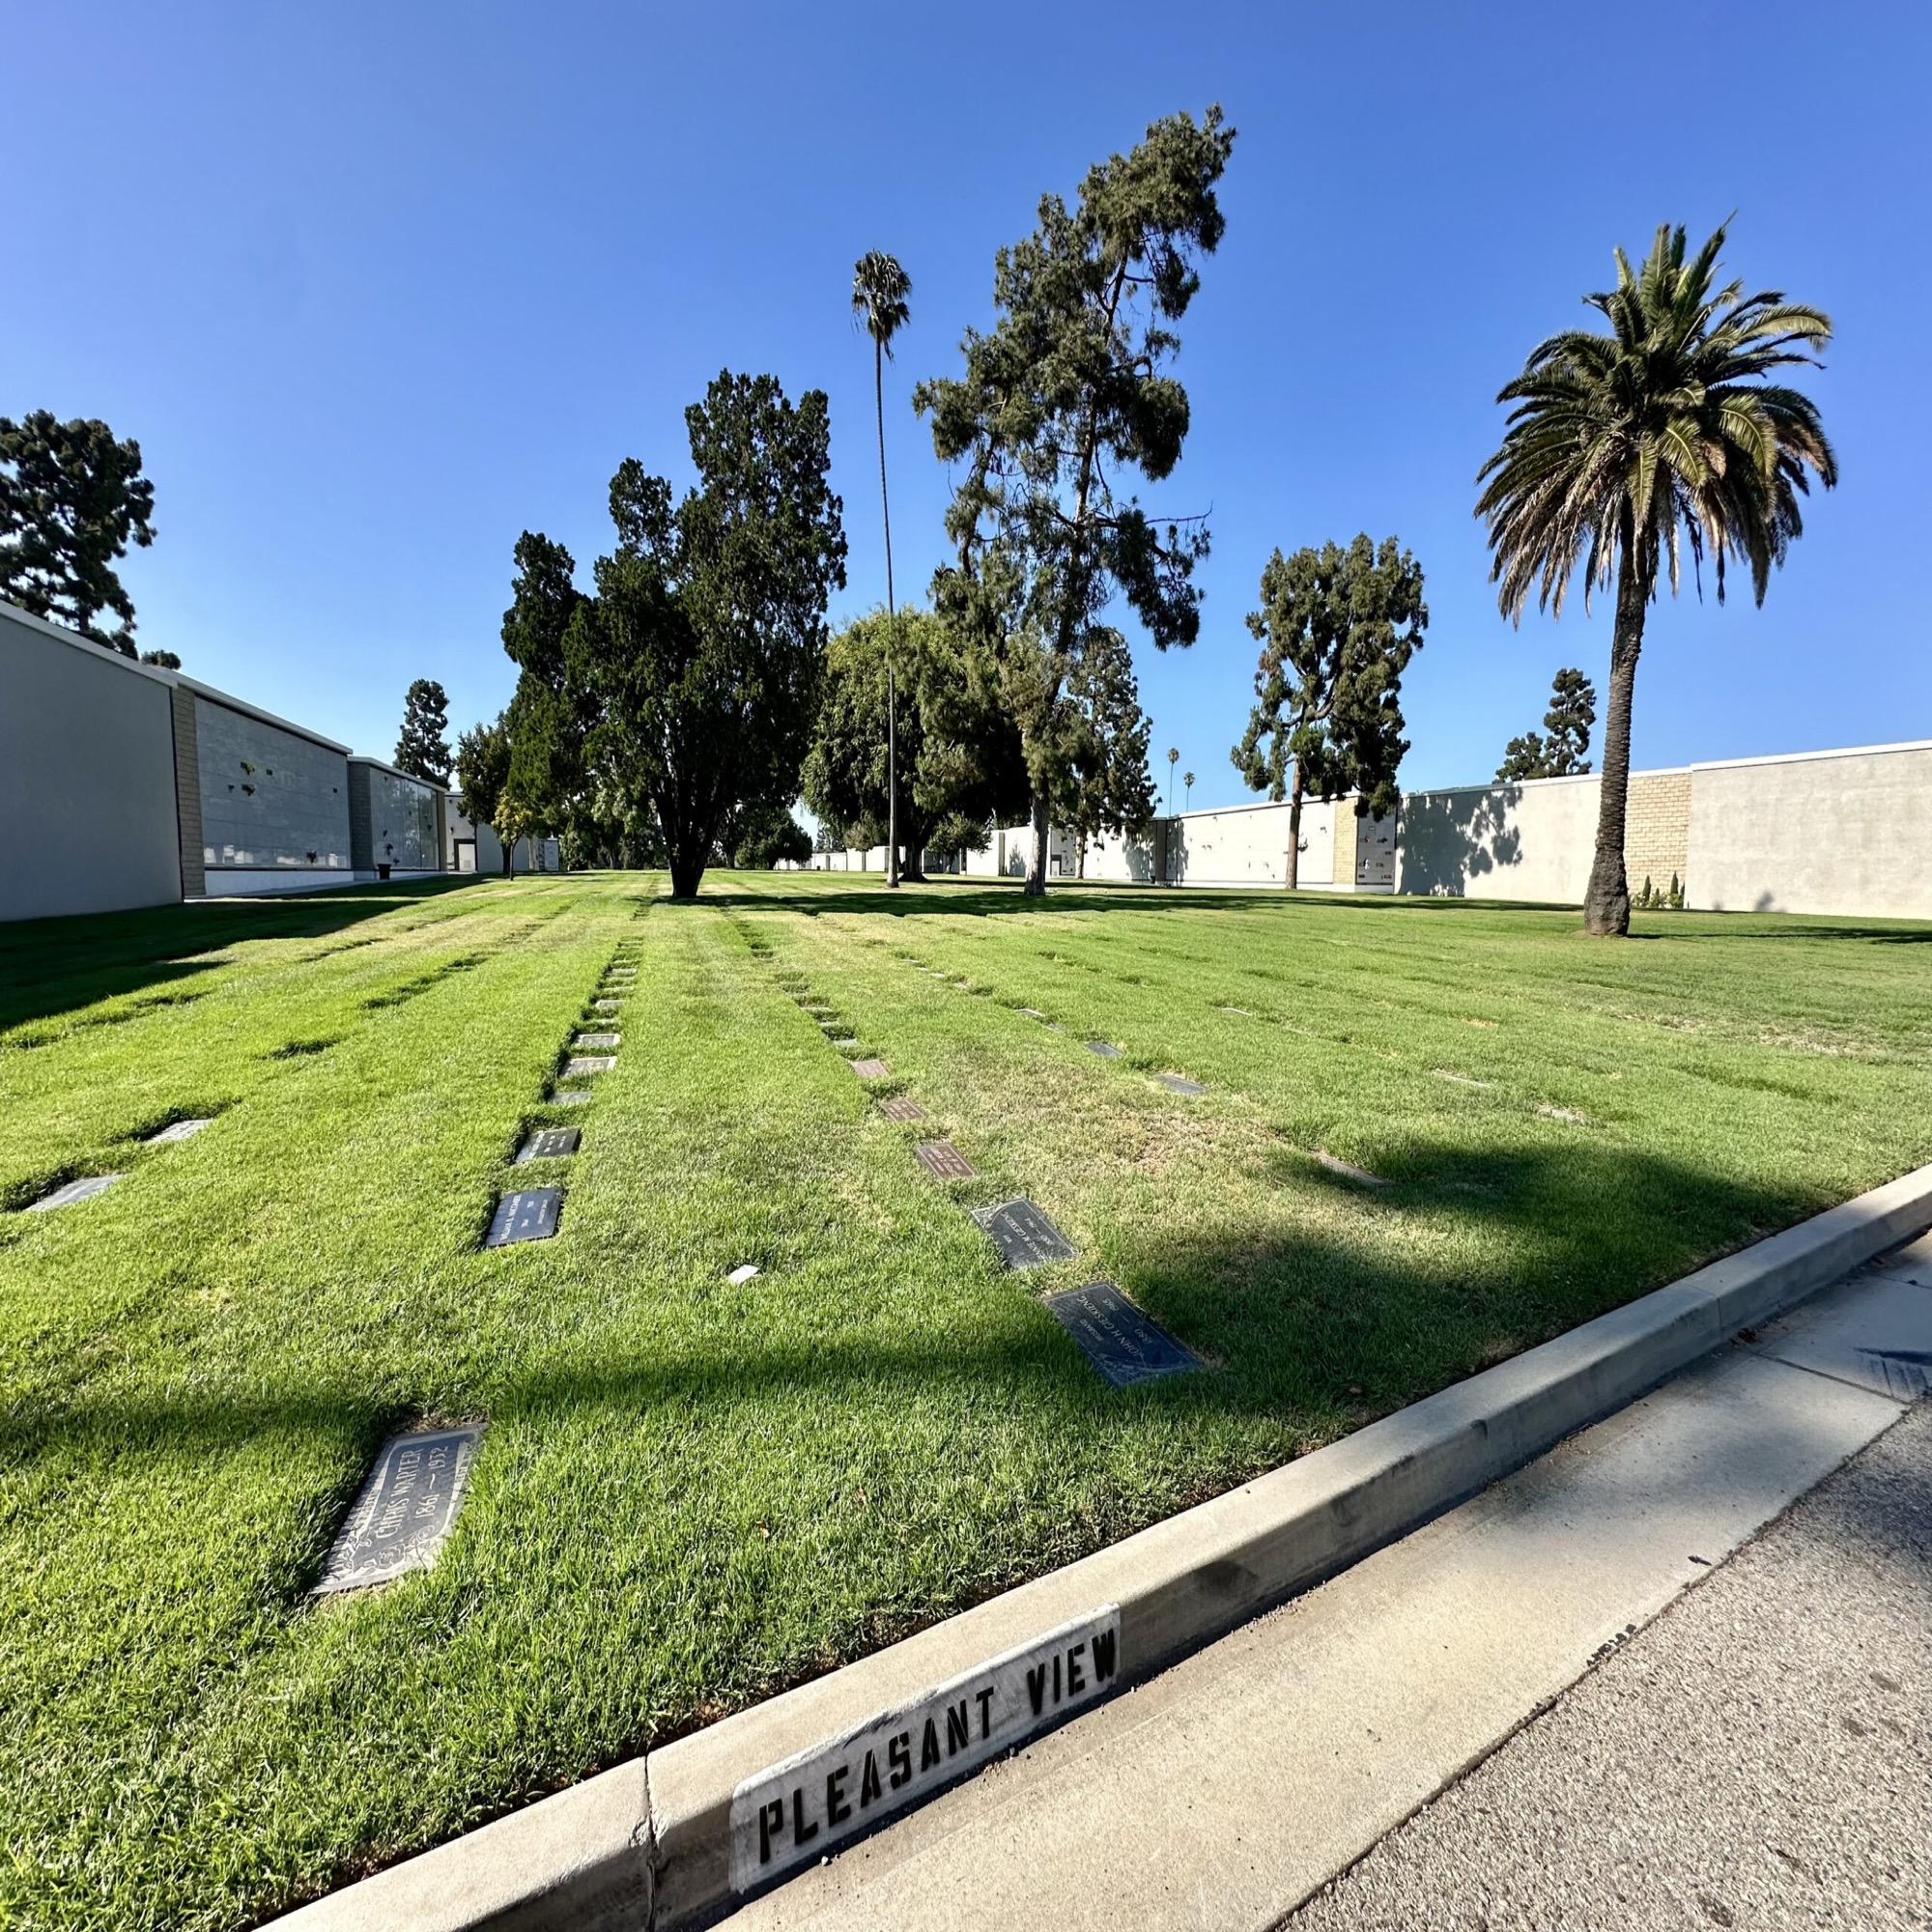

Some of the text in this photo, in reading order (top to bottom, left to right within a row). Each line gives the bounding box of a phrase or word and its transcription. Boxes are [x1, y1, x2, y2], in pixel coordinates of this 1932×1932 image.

[1077, 1295, 1115, 1330] GIESKIENG
[1080, 1319, 1104, 1341] HUSBAND
[1118, 1337, 1142, 1356] JOHN
[375, 1448, 423, 1539] CHRIS WARTER
[414, 1494, 440, 1519] 1861
[428, 1446, 448, 1469] 1932
[758, 1628, 1116, 1865] PLEASANT VIEW
